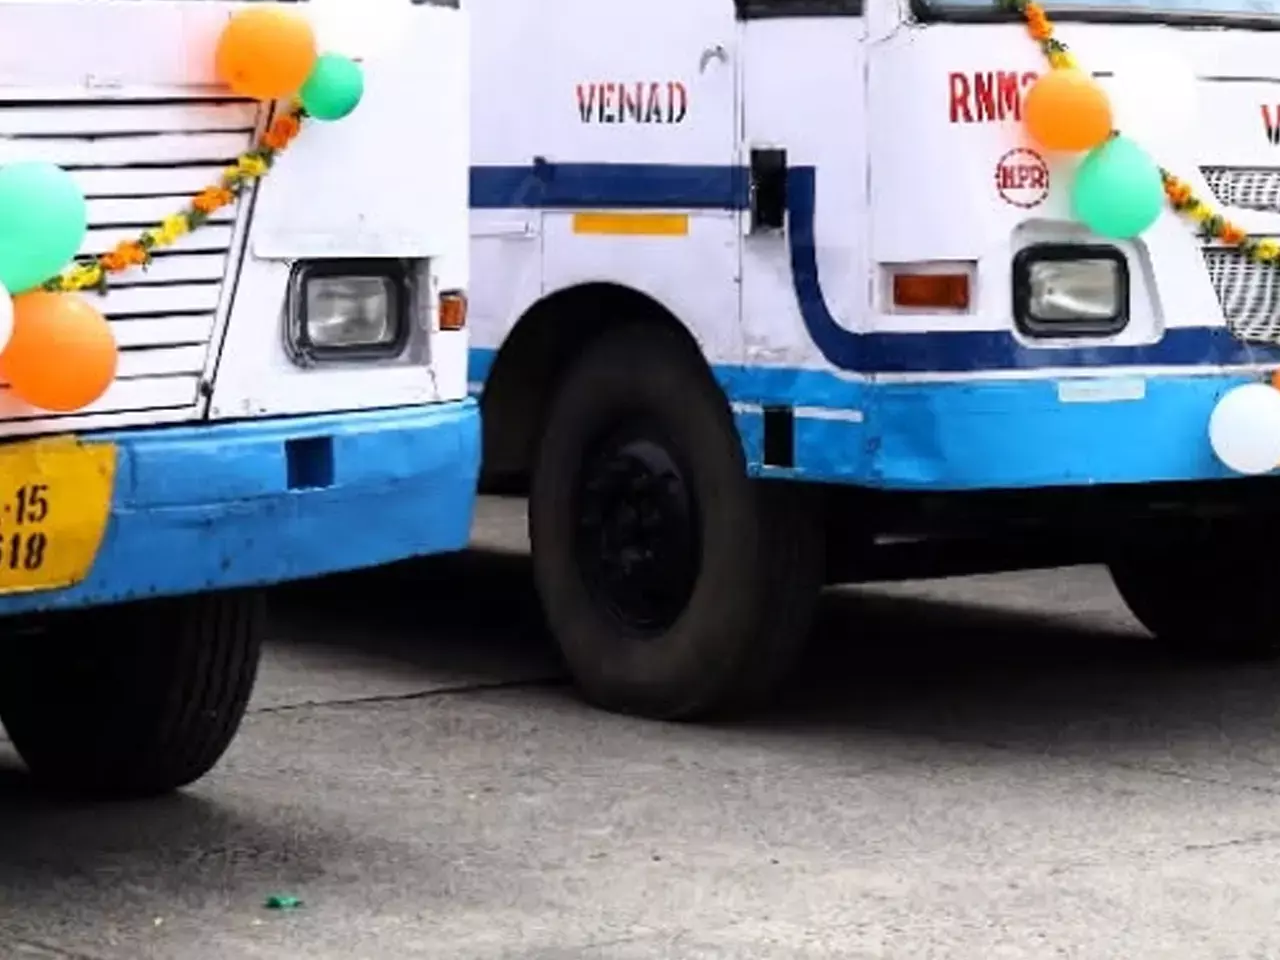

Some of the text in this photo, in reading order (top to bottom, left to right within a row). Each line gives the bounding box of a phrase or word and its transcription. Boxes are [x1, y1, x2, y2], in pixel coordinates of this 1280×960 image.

[576, 81, 687, 124] VENAD
[948, 70, 1039, 123] RNM
[0, 531, 47, 571] 18
